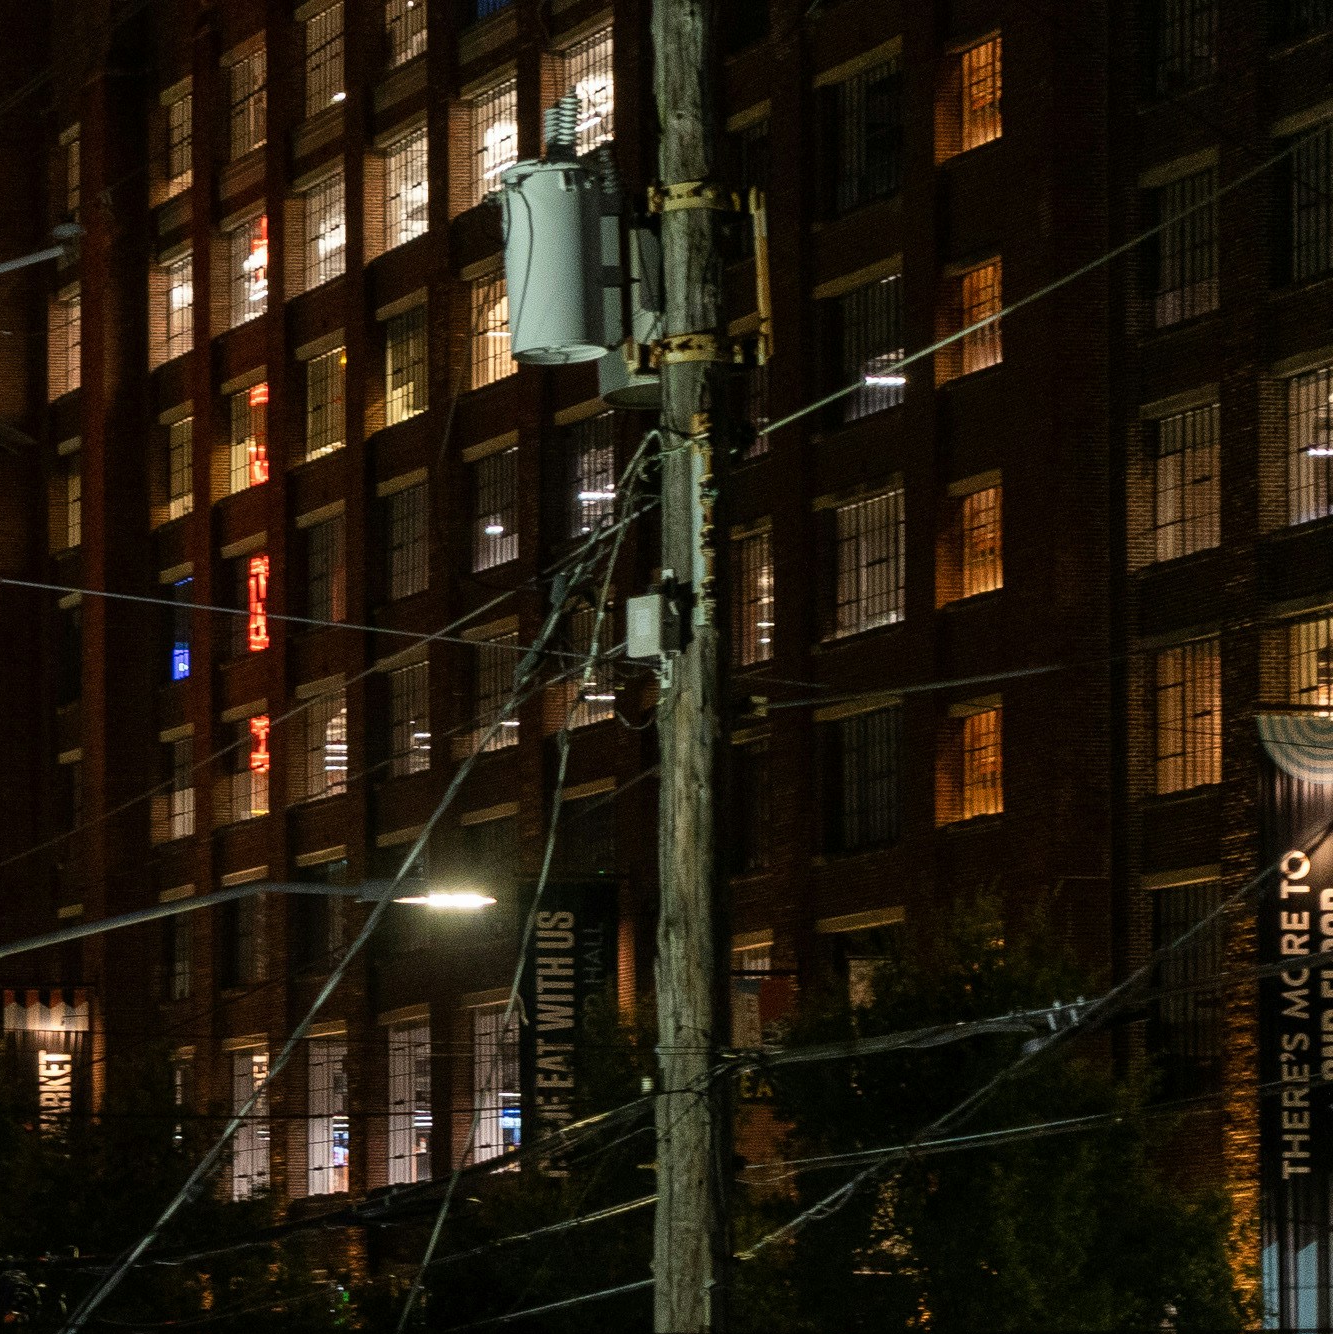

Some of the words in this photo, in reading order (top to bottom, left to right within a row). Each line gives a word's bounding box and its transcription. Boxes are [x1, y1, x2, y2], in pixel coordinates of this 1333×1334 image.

[1279, 849, 1311, 900] TO
[536, 909, 575, 950] US
[581, 922, 605, 986] HALL
[536, 955, 575, 1033] WITH
[1279, 909, 1311, 1020] MORE
[536, 1037, 574, 1089] EAT
[1279, 1031, 1312, 1181] THERE'S
